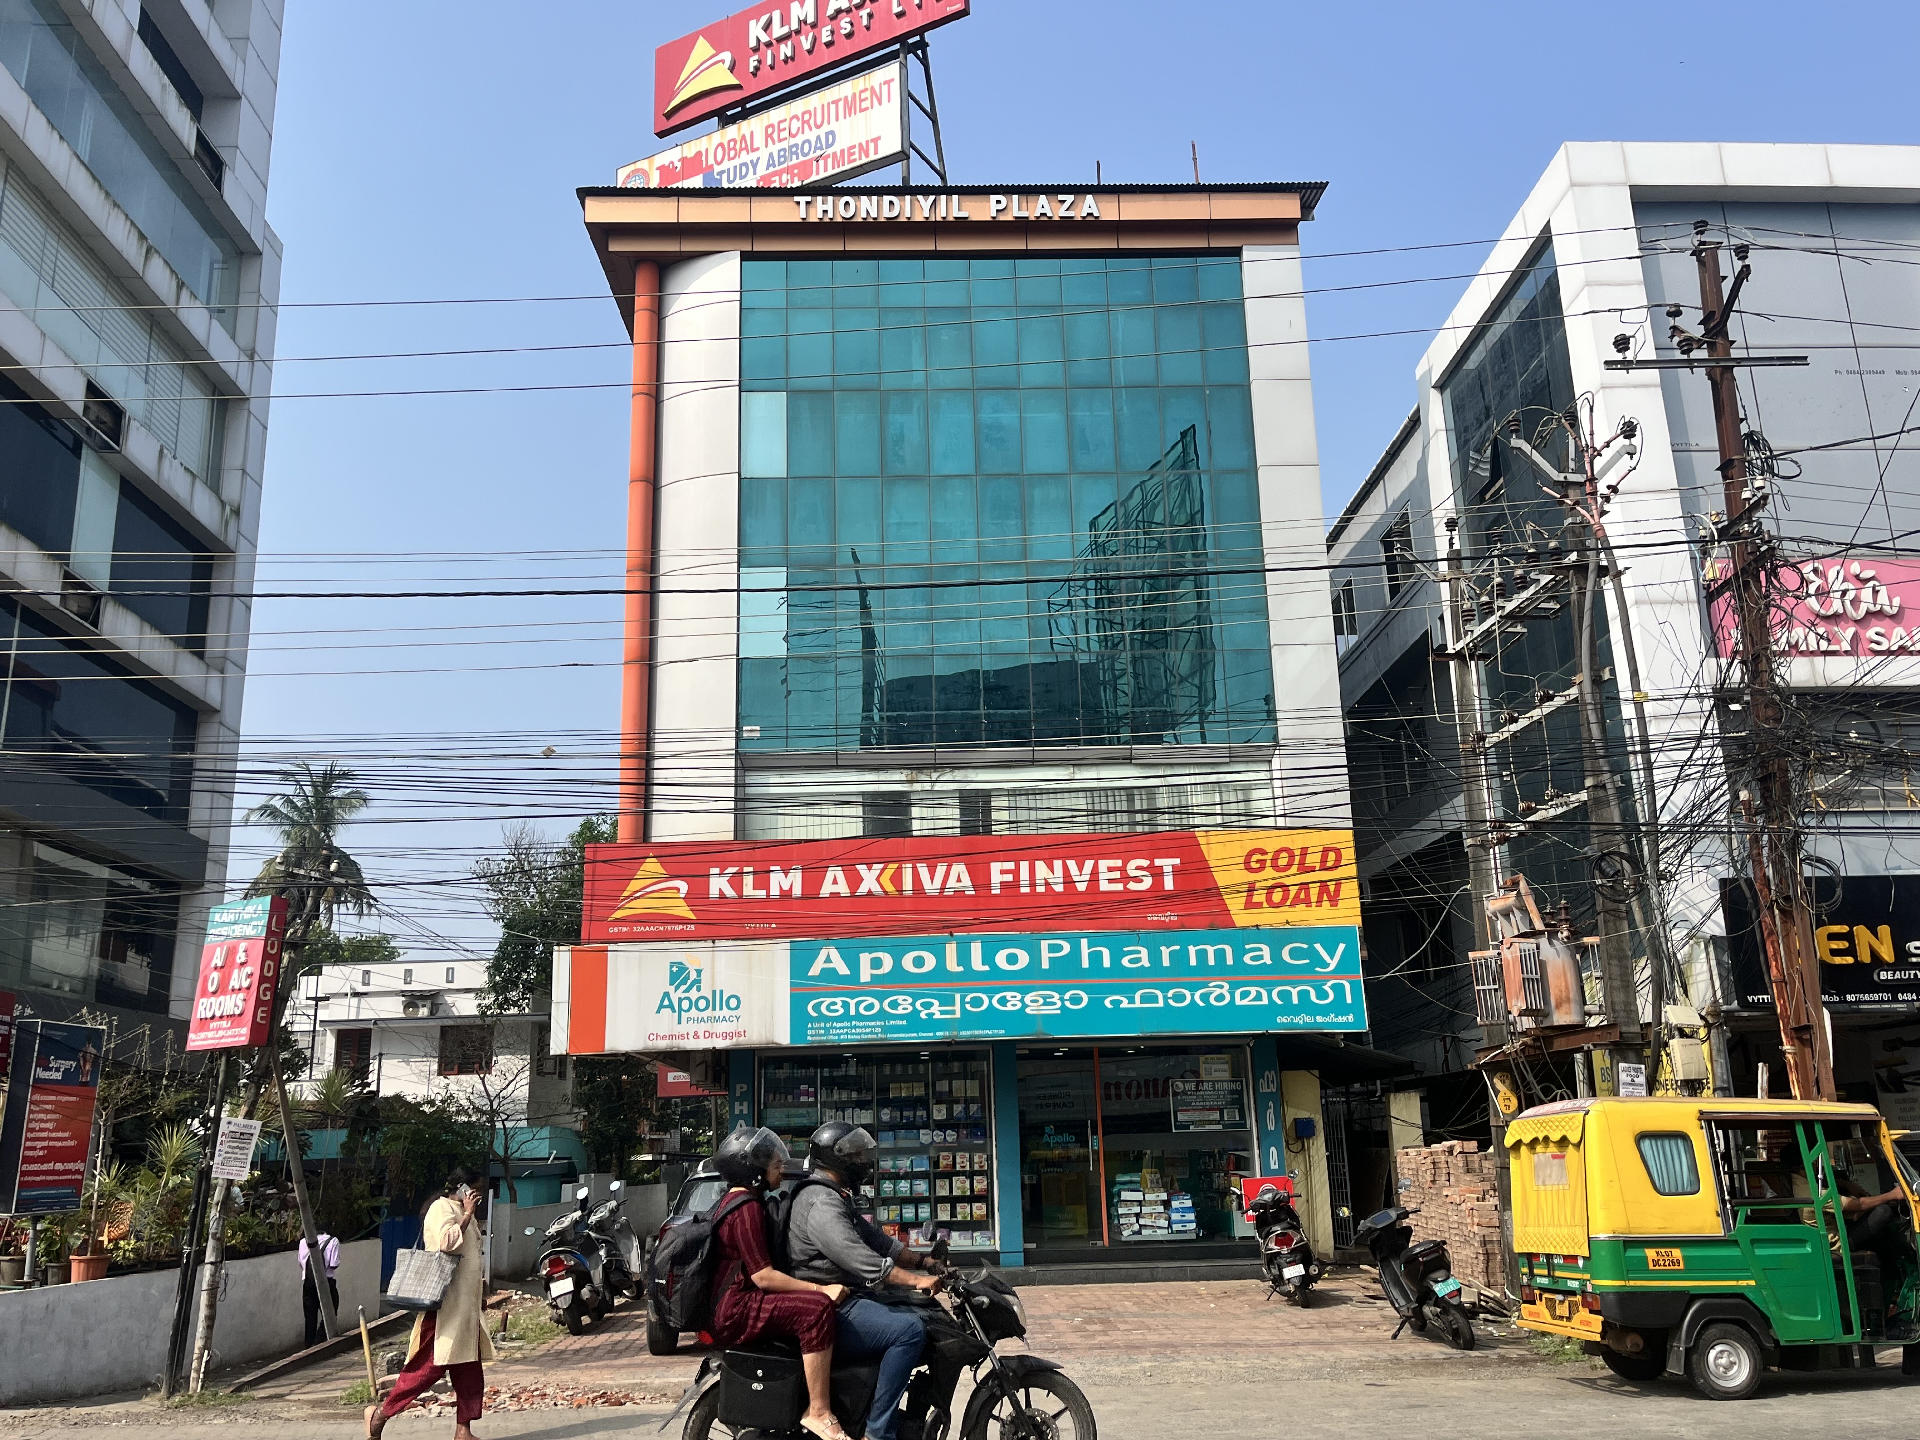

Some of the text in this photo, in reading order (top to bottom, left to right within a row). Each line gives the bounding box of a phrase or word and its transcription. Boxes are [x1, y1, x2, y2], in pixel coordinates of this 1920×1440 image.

[749, 0, 817, 52] KLM
[749, 9, 873, 76] FINVEST
[704, 78, 895, 170] LOBAL RECRUITMENT
[716, 129, 837, 185] TUDY ABROAD
[794, 194, 1101, 221] THONDIYIL PLAZA
[1243, 846, 1343, 875] GOLD
[708, 857, 1181, 900] KLM AXIVA FINVEST
[1243, 881, 1343, 909] LOAN
[236, 942, 248, 965] &
[229, 966, 253, 991] A/C
[256, 914, 281, 1025] LODGE
[1879, 971, 1920, 981] BEAUTY
[197, 993, 246, 1020] ROOMS
[656, 989, 741, 1024] Apollo
[807, 979, 1353, 1019] അപ്പോളോ ഫാർമസി
[686, 1015, 741, 1025] PHARMACY
[647, 1029, 748, 1042] Chemist & Druggist
[36, 1067, 63, 1080] Needed
[49, 1056, 77, 1071] Surgery
[1184, 1081, 1242, 1090] WE ARE HIRING
[1042, 1132, 1076, 1148] Apollo
